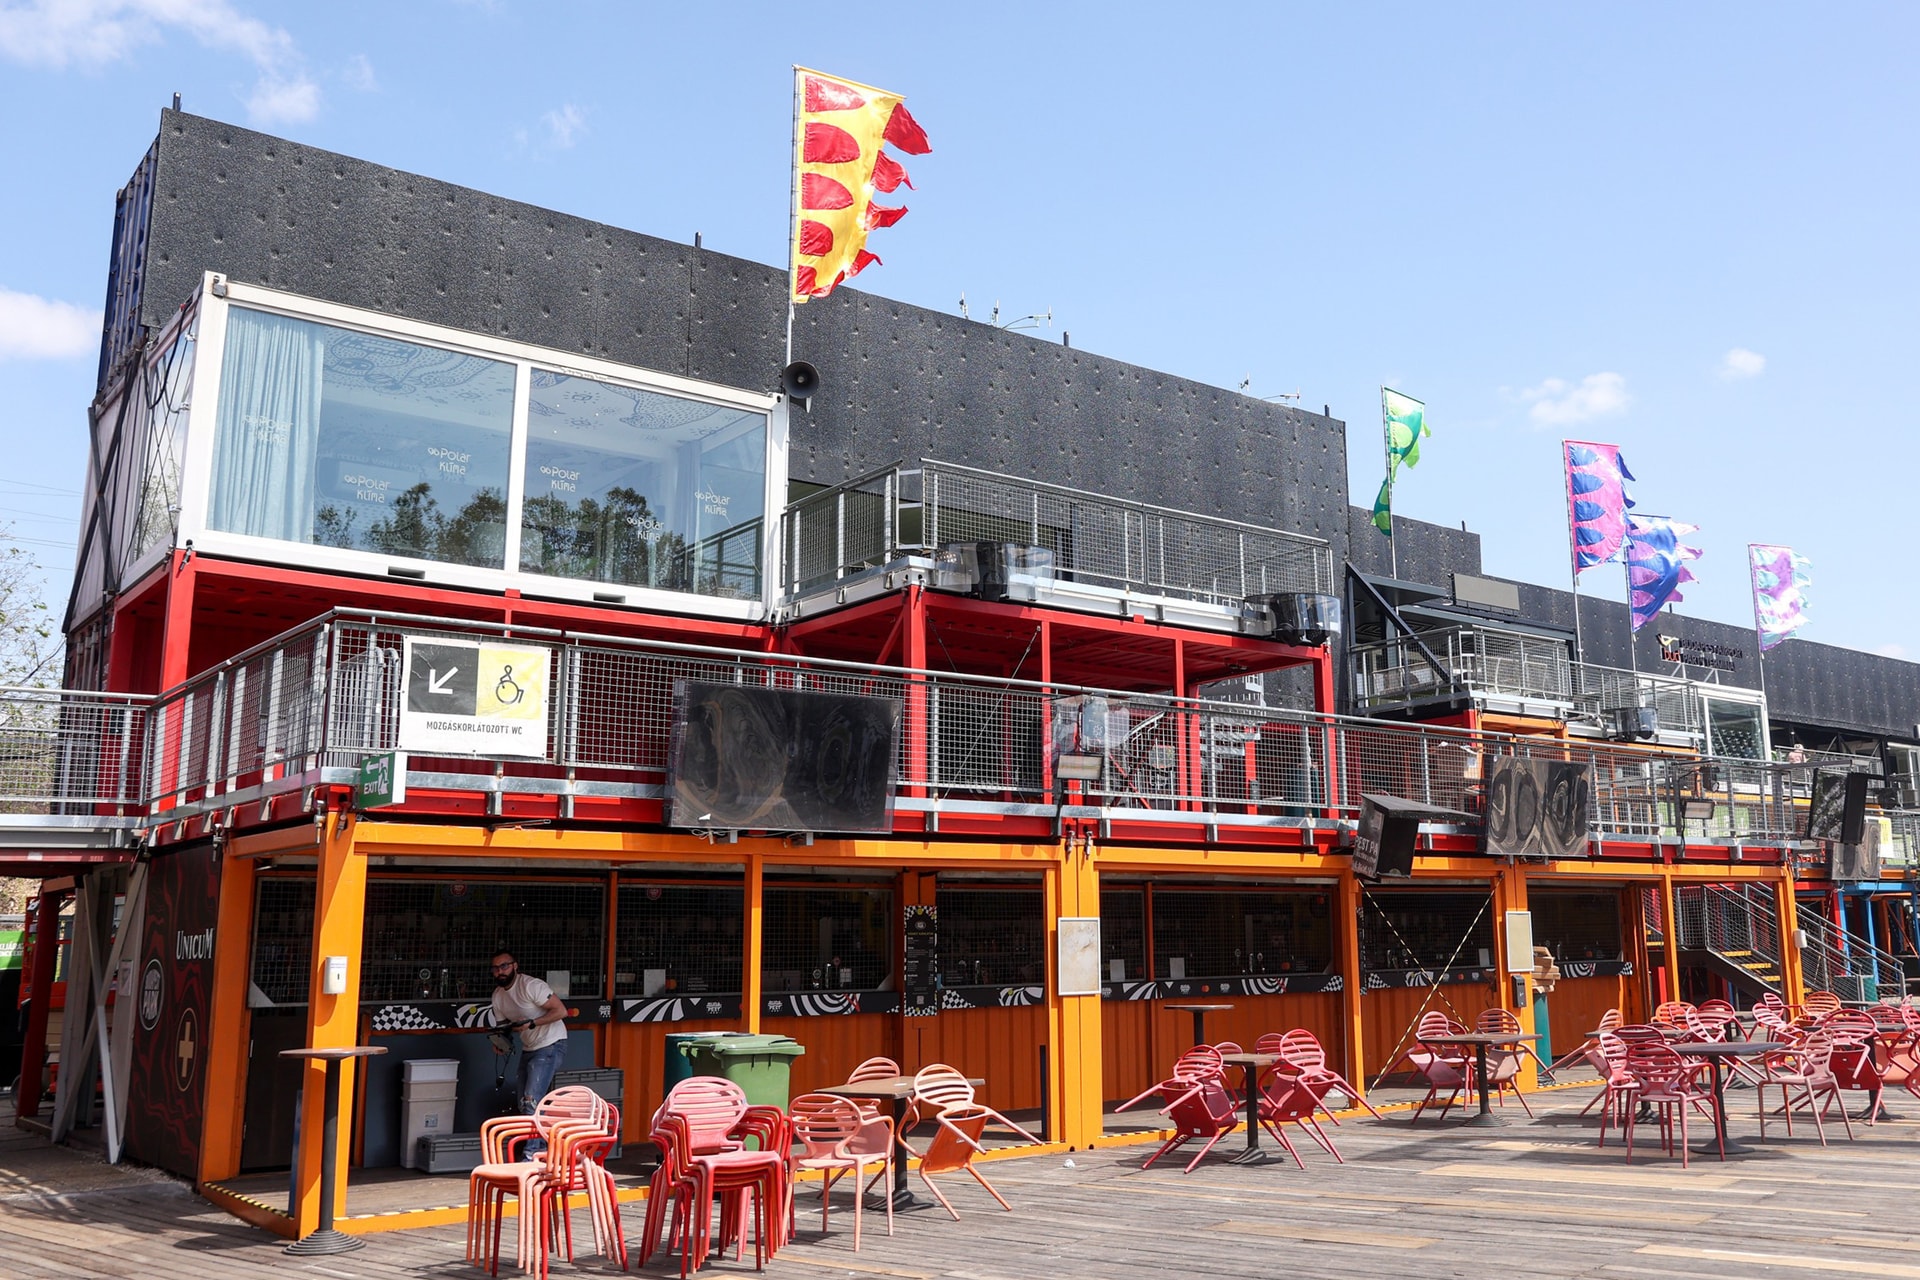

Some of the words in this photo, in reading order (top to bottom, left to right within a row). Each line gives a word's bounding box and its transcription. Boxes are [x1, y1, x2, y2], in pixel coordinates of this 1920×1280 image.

[440, 448, 472, 463] Polar
[551, 466, 581, 481] Polar
[357, 475, 391, 491] Polar
[705, 491, 731, 505] Polar
[637, 516, 665, 530] Polar
[426, 720, 509, 734] MOZGÁSKORLÁTOZOTT
[512, 726, 523, 735] WC
[363, 780, 379, 795] EXIT
